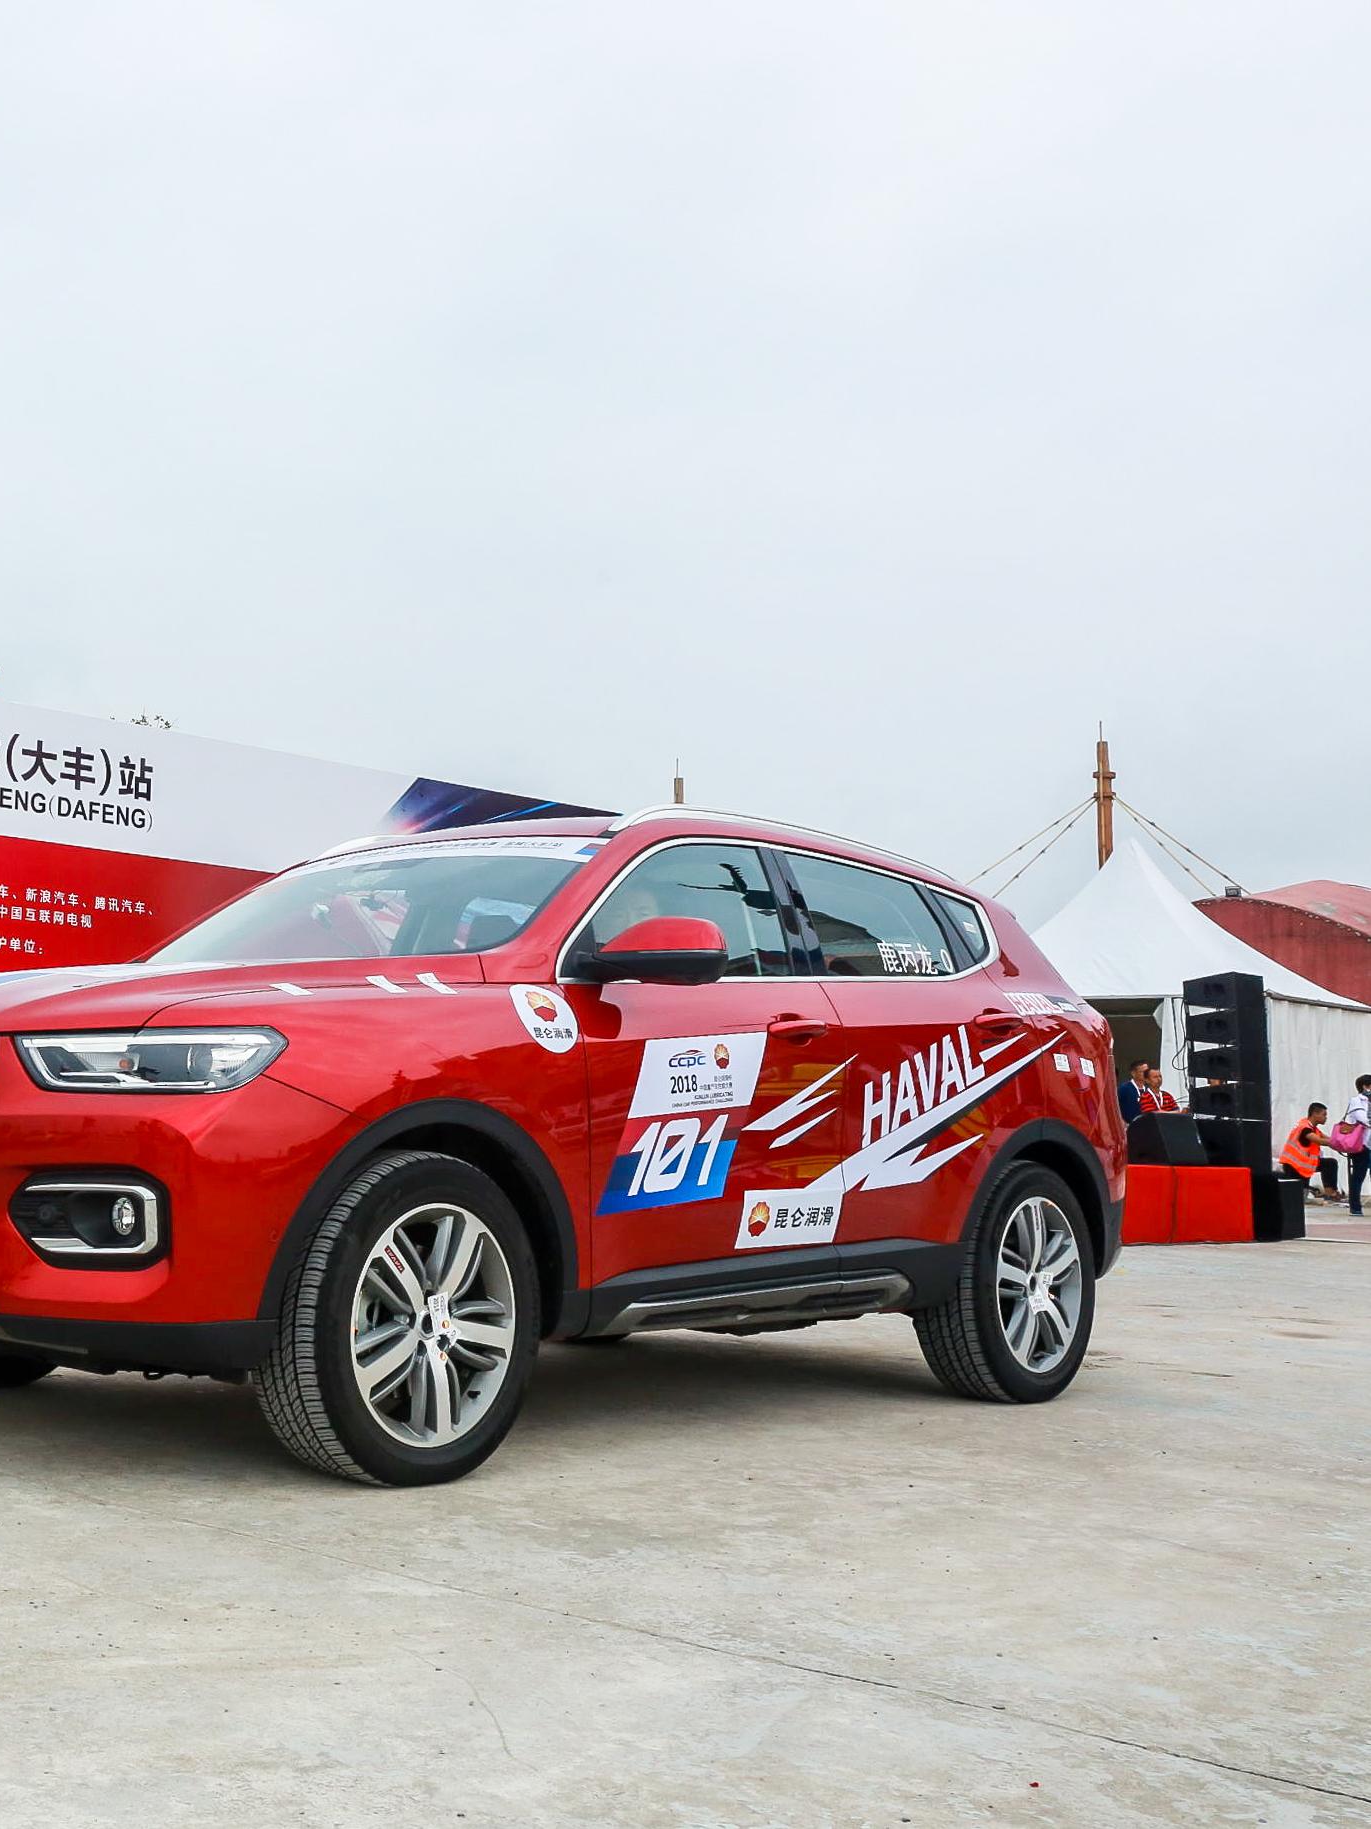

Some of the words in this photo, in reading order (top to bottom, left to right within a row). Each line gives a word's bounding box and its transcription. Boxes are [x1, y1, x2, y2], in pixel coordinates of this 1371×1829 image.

[533, 1027, 574, 1040] 昆仑润滑
[669, 1074, 698, 1094] 2018
[862, 1024, 986, 1149] HAVAL
[628, 1114, 728, 1196] 101
[773, 1206, 834, 1229] 昆仑润滑
